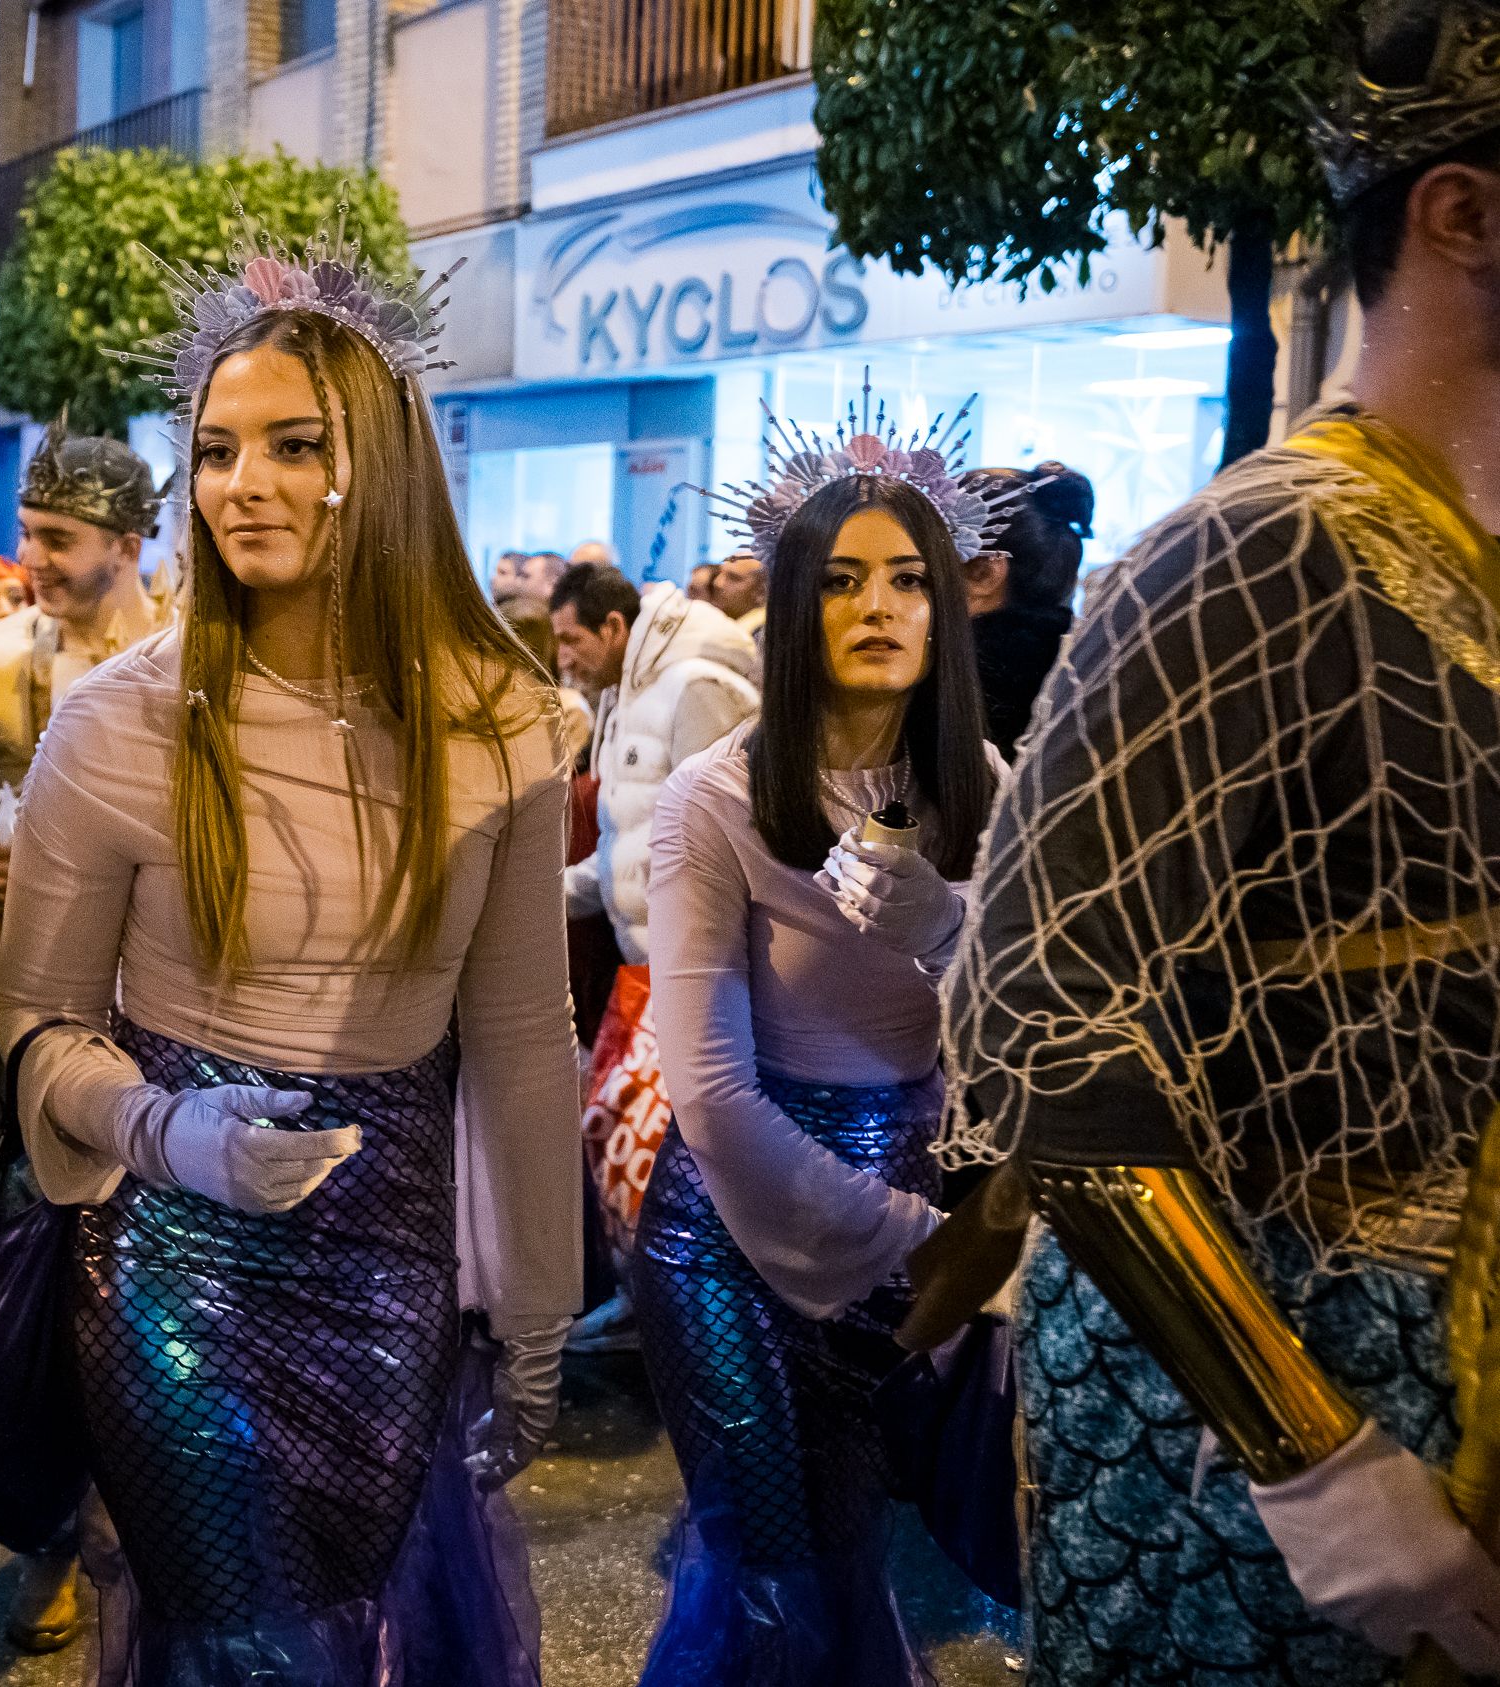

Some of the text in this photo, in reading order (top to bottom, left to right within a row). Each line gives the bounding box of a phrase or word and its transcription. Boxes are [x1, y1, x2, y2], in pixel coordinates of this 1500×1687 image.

[579, 252, 869, 364] KYCLOS
[938, 268, 1118, 311] DE CICLSMO
